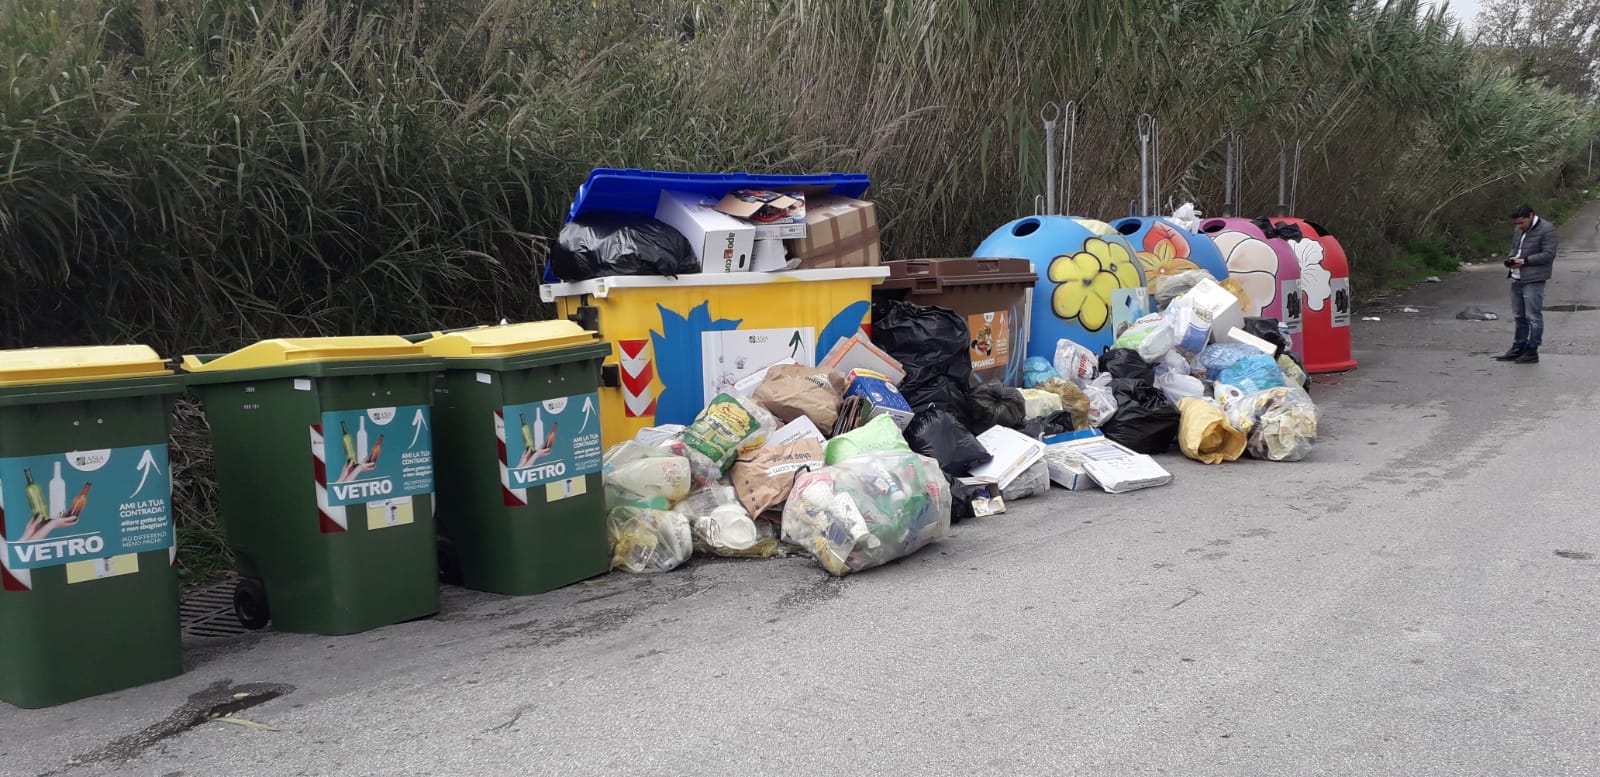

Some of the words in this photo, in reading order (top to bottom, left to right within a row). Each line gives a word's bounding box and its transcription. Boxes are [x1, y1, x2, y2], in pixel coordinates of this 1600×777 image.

[513, 462, 566, 484] VETRO
[333, 479, 393, 500] VETRO
[120, 502, 136, 510] AMI
[137, 501, 148, 509] LA
[148, 499, 165, 507] TUA
[14, 535, 104, 563] VETRO
